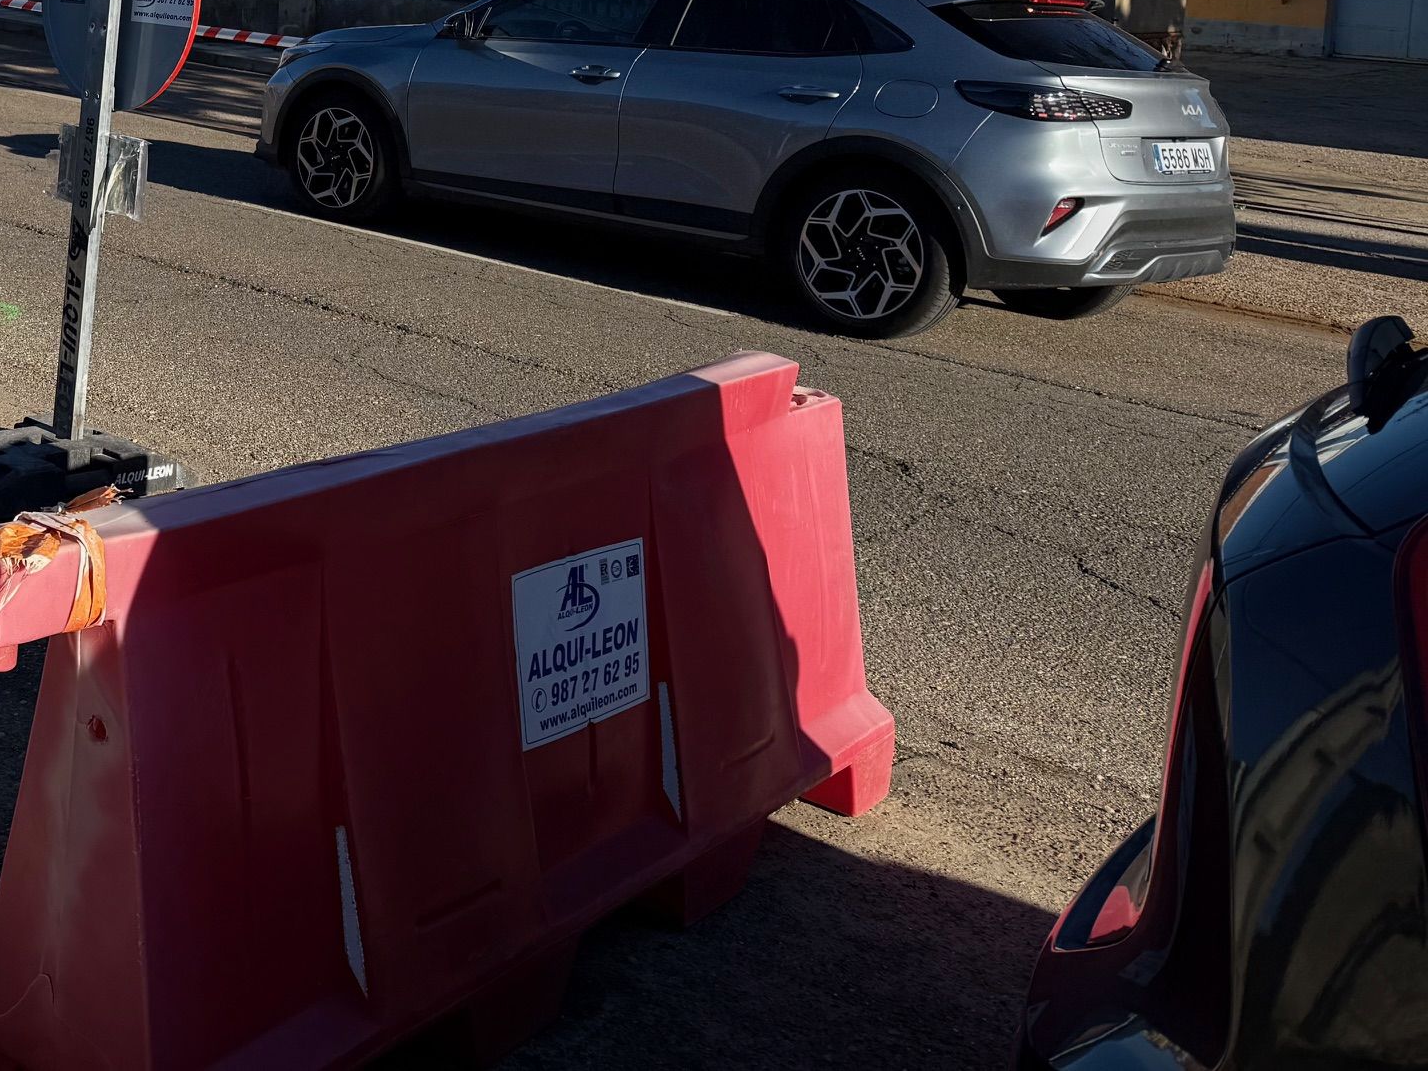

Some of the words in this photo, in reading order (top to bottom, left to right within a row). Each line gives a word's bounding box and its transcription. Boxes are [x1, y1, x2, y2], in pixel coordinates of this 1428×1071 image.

[1181, 105, 1203, 116] KIA
[84, 117, 95, 143] 987
[82, 146, 92, 165] 27
[1161, 148, 1190, 169] 5586
[80, 169, 90, 188] 62
[79, 191, 89, 210] 95
[114, 463, 174, 485] ALQUI-LEON
[528, 618, 639, 683] ALQUI-LEON
[551, 675, 578, 707] 987
[581, 668, 599, 695] 27
[604, 660, 620, 686] 62
[624, 652, 640, 677] 95
[540, 683, 638, 731] www.alquileon.com
